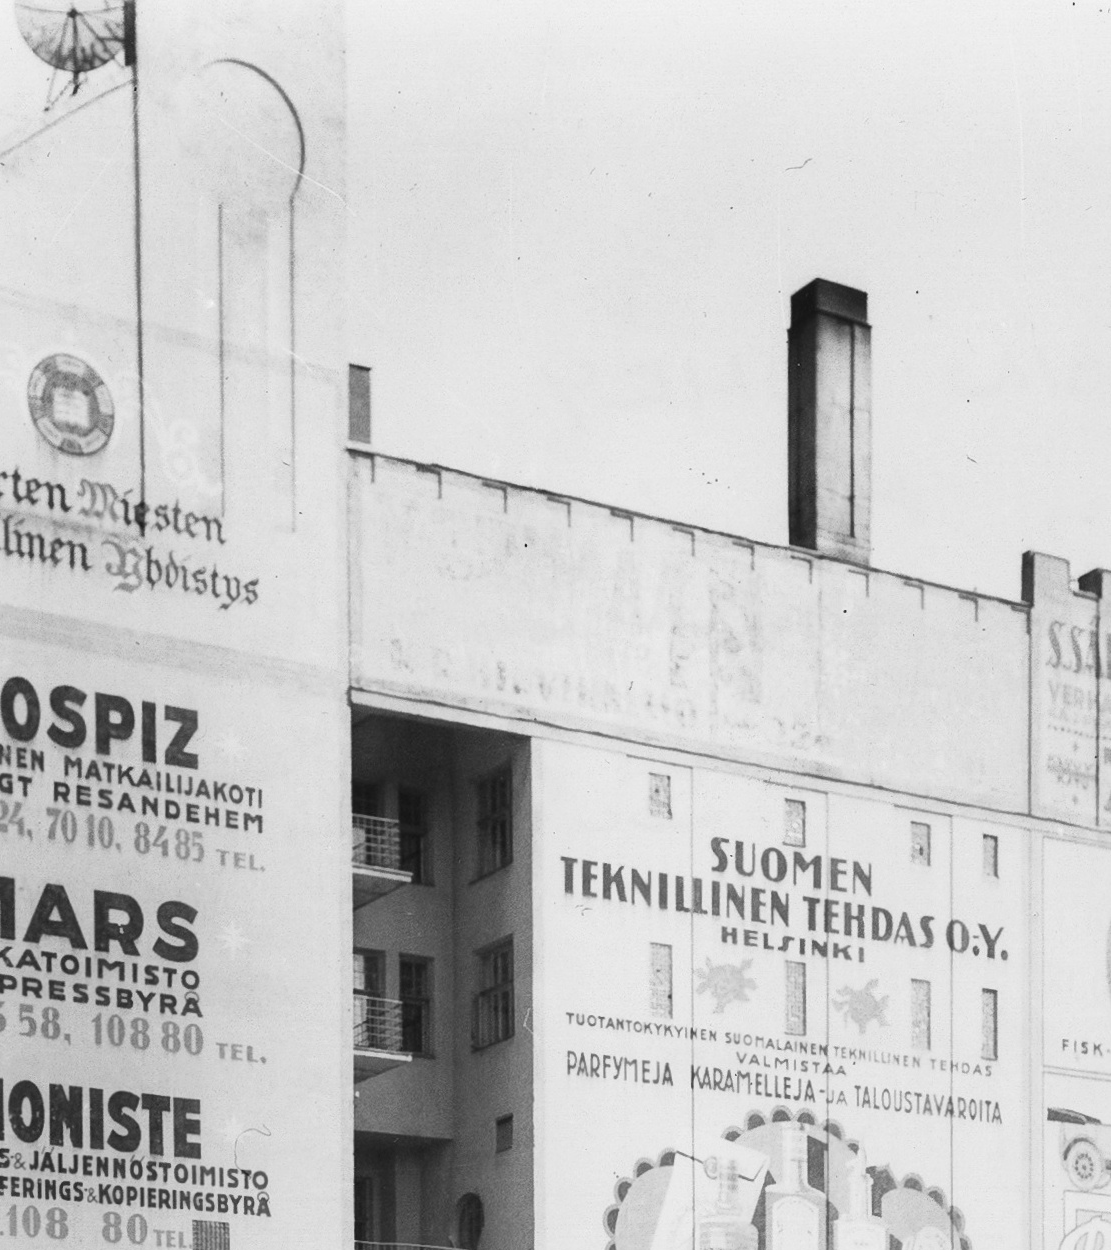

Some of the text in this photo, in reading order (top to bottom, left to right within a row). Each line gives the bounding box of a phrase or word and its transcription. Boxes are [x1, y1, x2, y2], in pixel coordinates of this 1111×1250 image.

[54, 781, 263, 833] RESANDEHEM
[64, 755, 263, 808] MATKAILIJAKOTI
[216, 848, 266, 872] TEL.
[711, 836, 872, 897] SUOMEN
[560, 856, 789, 928] TEKNILLINEN
[804, 896, 935, 950] TEHDAS
[721, 926, 865, 963] HELSINKI
[215, 1042, 267, 1064] TEL.
[566, 1012, 992, 1078] TUOTANTOKYKYINEN SUOMALAINEN TEKNILLINEN TEHDAS
[736, 1052, 847, 1076] VALMISTAA
[566, 1051, 674, 1087] PARFYMEJA
[854, 1085, 1002, 1125] TALOUSTAVAROITA
[6, 1204, 69, 1240] 108
[102, 1211, 148, 1245] 80
